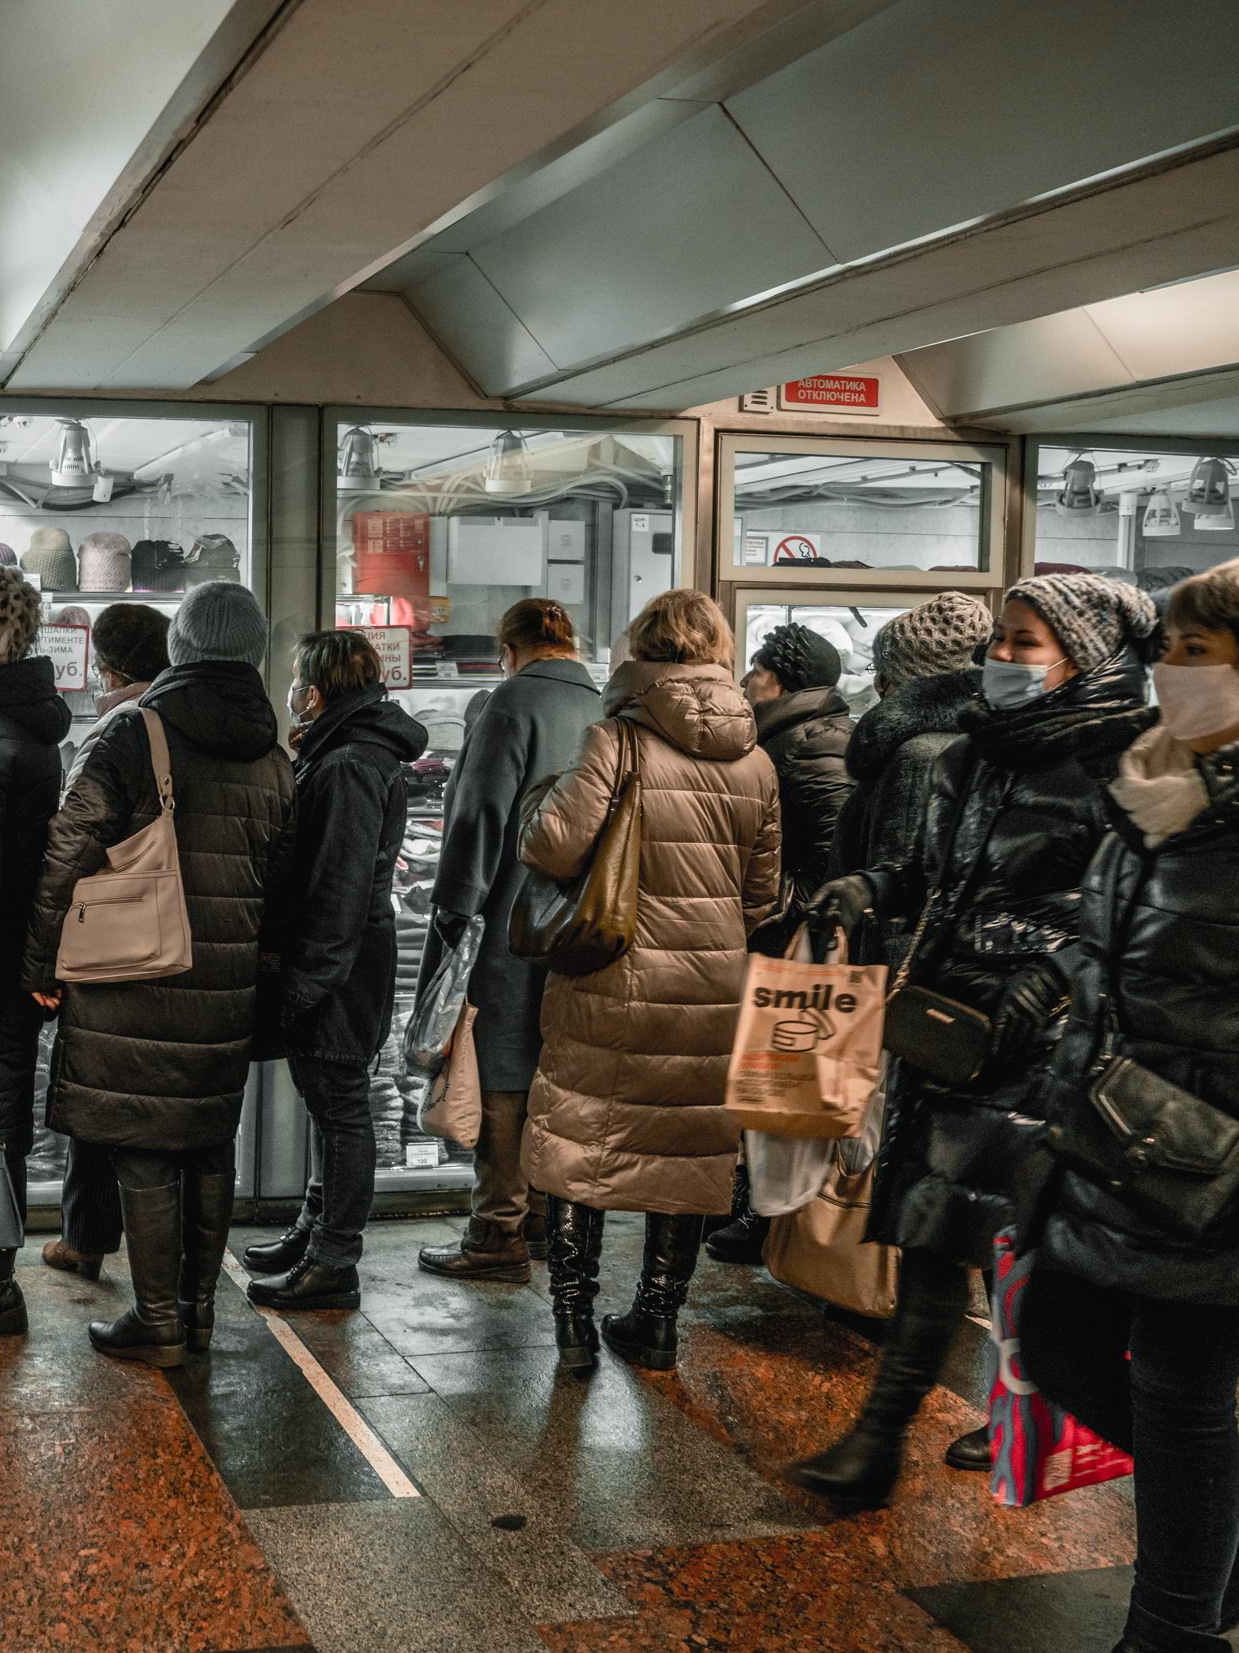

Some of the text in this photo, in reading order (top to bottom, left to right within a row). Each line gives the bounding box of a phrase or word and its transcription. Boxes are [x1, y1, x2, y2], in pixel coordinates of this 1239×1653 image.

[797, 378, 866, 392] АВТОМАТИКА
[797, 389, 866, 403] ОТКЛЮЧЕНА
[44, 626, 77, 634] ШАПКИ
[39, 645, 74, 654] Ь-ЗИМА
[374, 642, 400, 651] АТКИ
[55, 661, 83, 680] уб.
[380, 665, 407, 683] уб.
[754, 983, 858, 1014] smile
